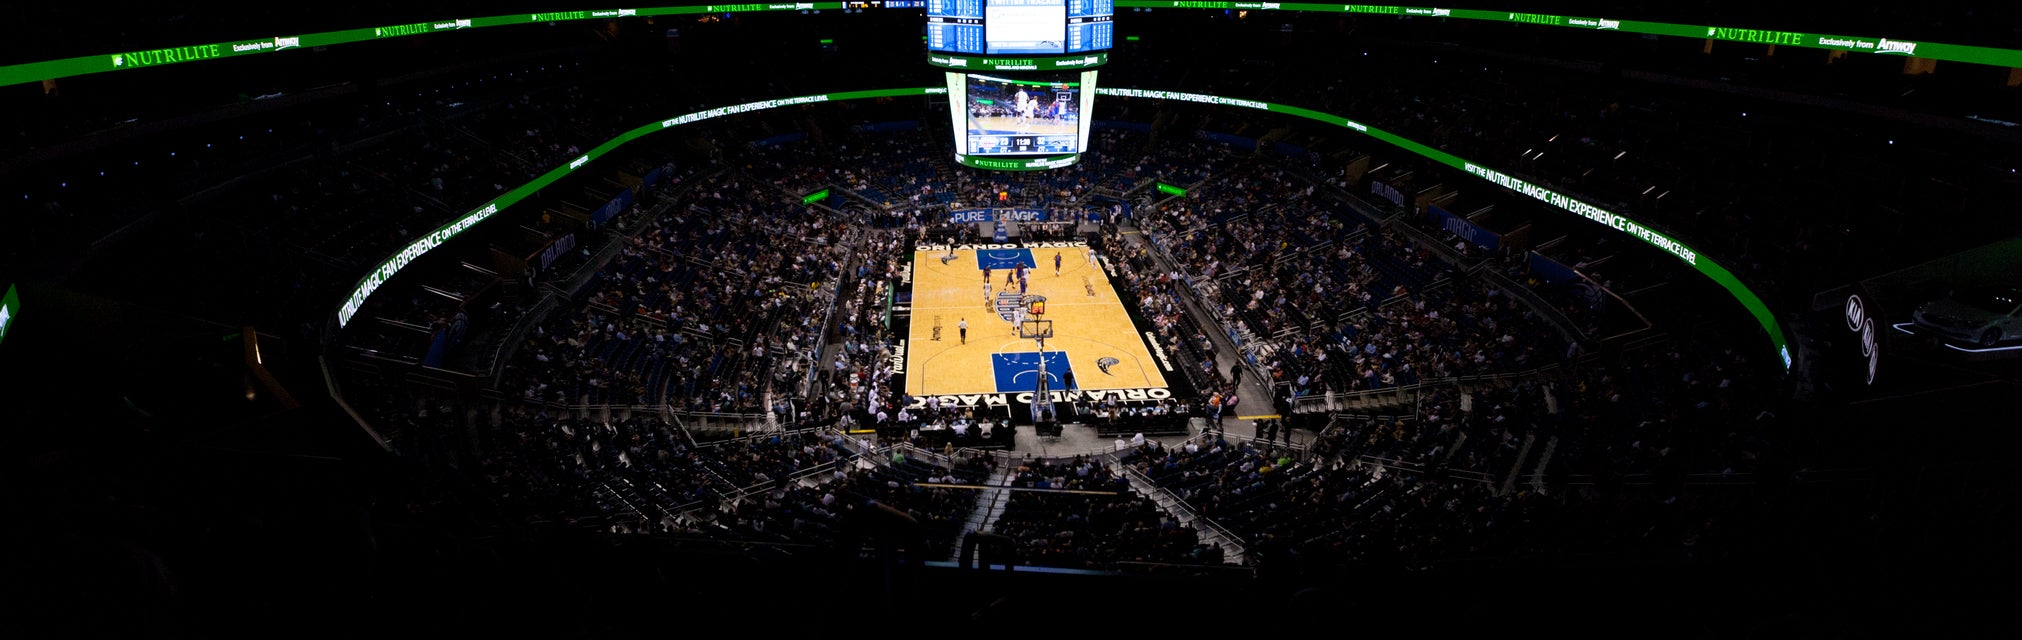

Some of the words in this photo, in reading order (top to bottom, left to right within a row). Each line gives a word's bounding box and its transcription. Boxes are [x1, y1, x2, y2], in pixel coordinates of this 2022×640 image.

[713, 3, 762, 12] NUTRILITE
[1178, 1, 1228, 9] NUTRILITE
[1350, 4, 1399, 15] NUTRILITE
[538, 11, 585, 22] NUTRILITE
[1513, 12, 1561, 26] NUTRILITE
[1597, 18, 1620, 30] Amway
[382, 23, 429, 37] NUTRILITE
[1716, 27, 1803, 46] NUTRILITE
[233, 43, 261, 52] Exclusively
[261, 40, 274, 50] from
[275, 36, 300, 51] Amway
[1819, 37, 1856, 50] Exclusively
[1855, 40, 1875, 50] from
[1874, 38, 1917, 55] Amway
[127, 44, 220, 67] NUTRILITE
[1109, 88, 1142, 97] NUTRILITE
[1143, 90, 1165, 99] MAGIC
[1166, 91, 1180, 100] FAN
[1180, 92, 1219, 104] EXPERIENCE
[679, 110, 708, 124] NUTRILITE
[707, 106, 728, 118] MAGIC
[727, 104, 741, 115] FAN
[741, 99, 777, 113] EXPERIENCE
[979, 160, 1019, 169] NUTRILITE
[954, 211, 985, 223] PURE
[1000, 211, 1040, 222] MAGIC
[1464, 162, 1477, 174] VISIT
[1475, 166, 1487, 178] THE
[1485, 169, 1523, 193] NUTRILITE
[1522, 182, 1551, 203] MAGIC
[1550, 193, 1569, 211] FAN
[1569, 199, 1627, 232] EXPERIENCE
[1626, 222, 1638, 235] ON
[1637, 225, 1652, 242] THE
[1649, 231, 1682, 256] TERRACE
[1679, 246, 1696, 266] LEVEL
[1446, 217, 1478, 242] MAGIC
[360, 268, 384, 301] MAGIC
[381, 257, 398, 282] FAN
[396, 231, 442, 270] EXPERIENCE
[441, 227, 452, 240] ON
[450, 221, 463, 235] THE
[461, 209, 484, 229] TERRACE
[482, 203, 498, 218] LEVEL
[1022, 241, 1088, 249] MAGIC
[907, 393, 1008, 410] MAGC
